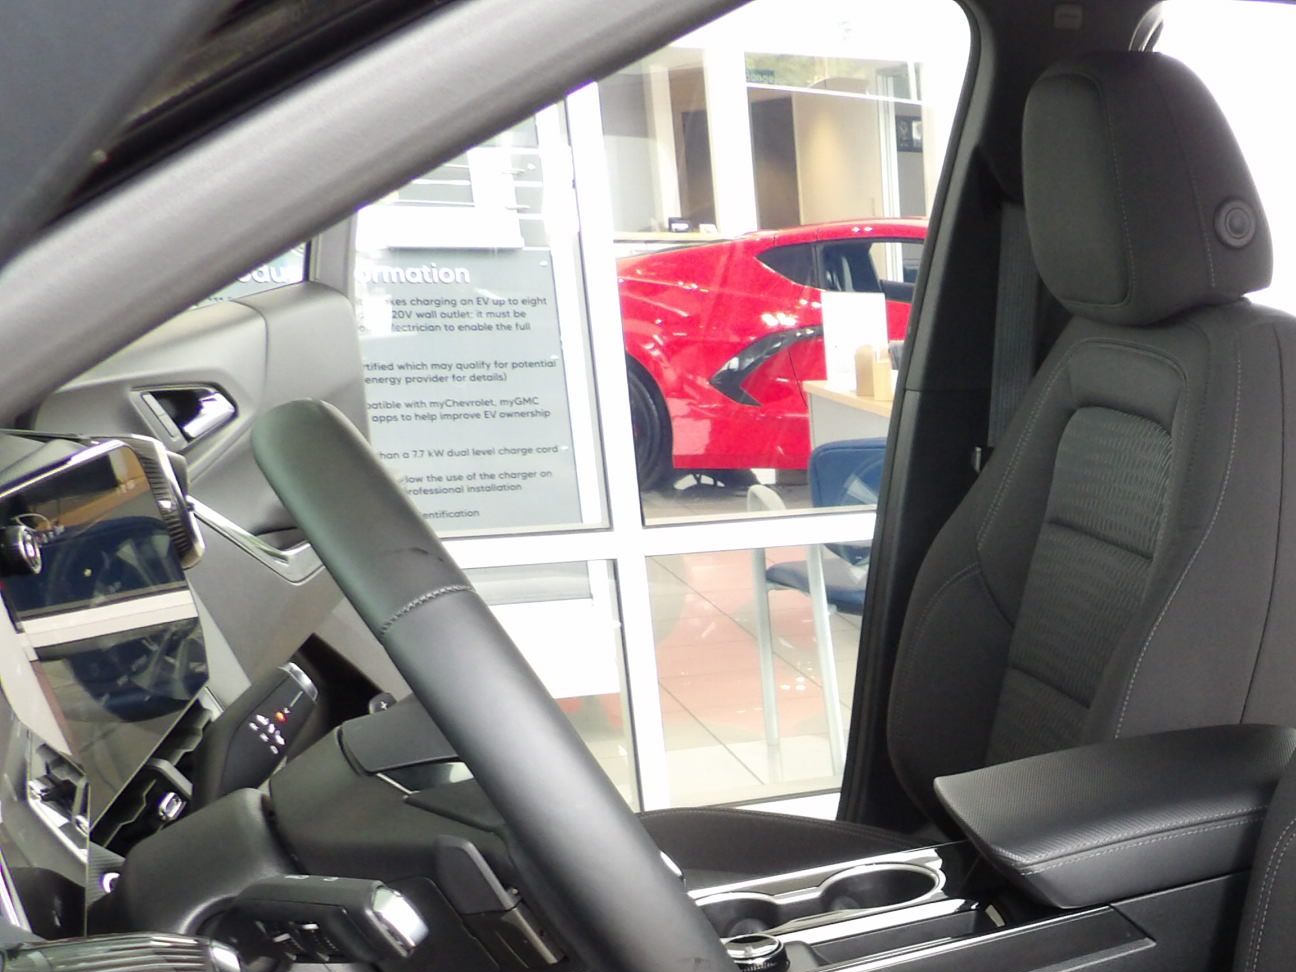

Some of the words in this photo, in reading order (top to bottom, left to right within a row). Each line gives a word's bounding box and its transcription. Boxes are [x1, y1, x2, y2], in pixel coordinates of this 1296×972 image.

[410, 297, 457, 308] charging
[476, 297, 489, 306] EV
[492, 298, 505, 307] up
[508, 297, 519, 306] to
[521, 296, 547, 307] eight
[416, 310, 437, 319] wall
[476, 310, 483, 318] it
[486, 310, 510, 318] must
[513, 310, 526, 318] be
[444, 323, 455, 332] to
[458, 322, 493, 332] enable
[496, 322, 512, 331] the
[515, 322, 531, 331] full
[397, 361, 428, 371] which
[431, 363, 452, 372] may
[456, 360, 491, 371] qualify
[494, 360, 508, 369] for
[512, 359, 557, 370] potential
[364, 376, 402, 386] energy
[405, 374, 449, 385] provider
[452, 373, 466, 383] for
[469, 373, 507, 383] details)
[405, 400, 427, 409] with
[500, 397, 539, 408] myGMC
[372, 412, 398, 423] apps
[401, 413, 412, 422] to
[415, 411, 437, 422] help
[440, 411, 481, 421] improve
[484, 410, 497, 420] EV
[499, 409, 551, 420] ownership
[428, 449, 445, 457] kW
[447, 448, 469, 457] dual
[472, 447, 496, 457] level
[498, 446, 534, 457] charge
[536, 445, 558, 454] cord
[426, 473, 443, 482] the
[446, 474, 464, 482] use
[467, 472, 478, 481] of
[479, 472, 496, 481] the
[498, 470, 537, 481] charger
[541, 471, 553, 479] on
[467, 483, 523, 493] installation
